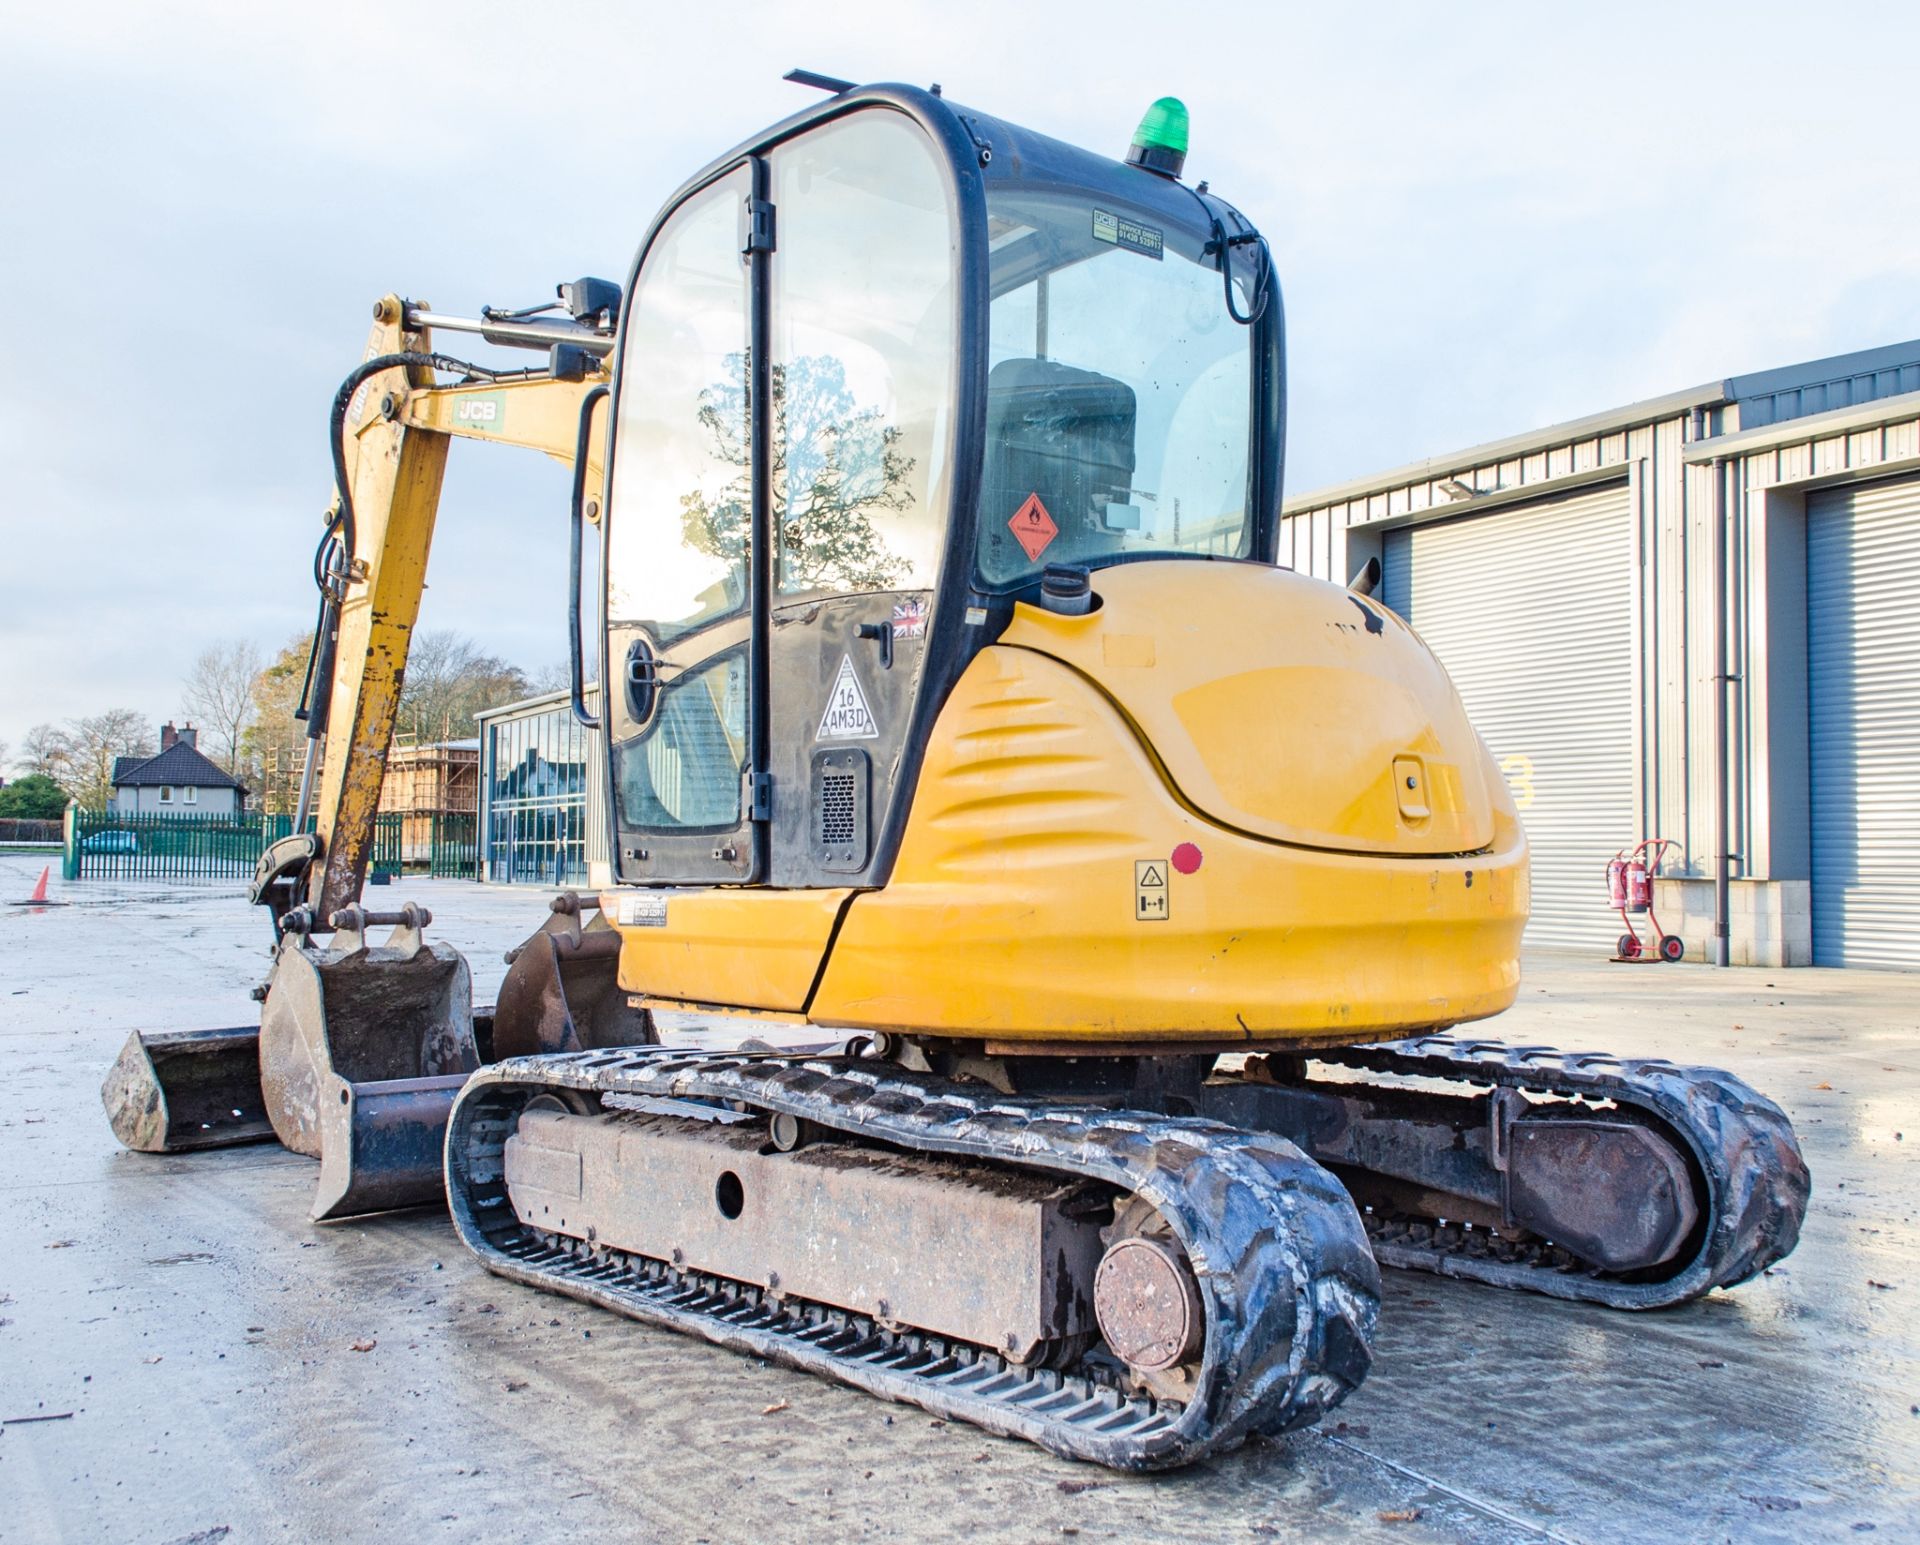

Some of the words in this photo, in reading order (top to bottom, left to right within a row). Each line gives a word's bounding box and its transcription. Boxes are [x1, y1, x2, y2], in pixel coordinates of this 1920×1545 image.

[1096, 213, 1115, 227] JCB
[459, 400, 497, 420] JCB
[840, 687, 854, 708] 16
[830, 708, 864, 730] AM3D
